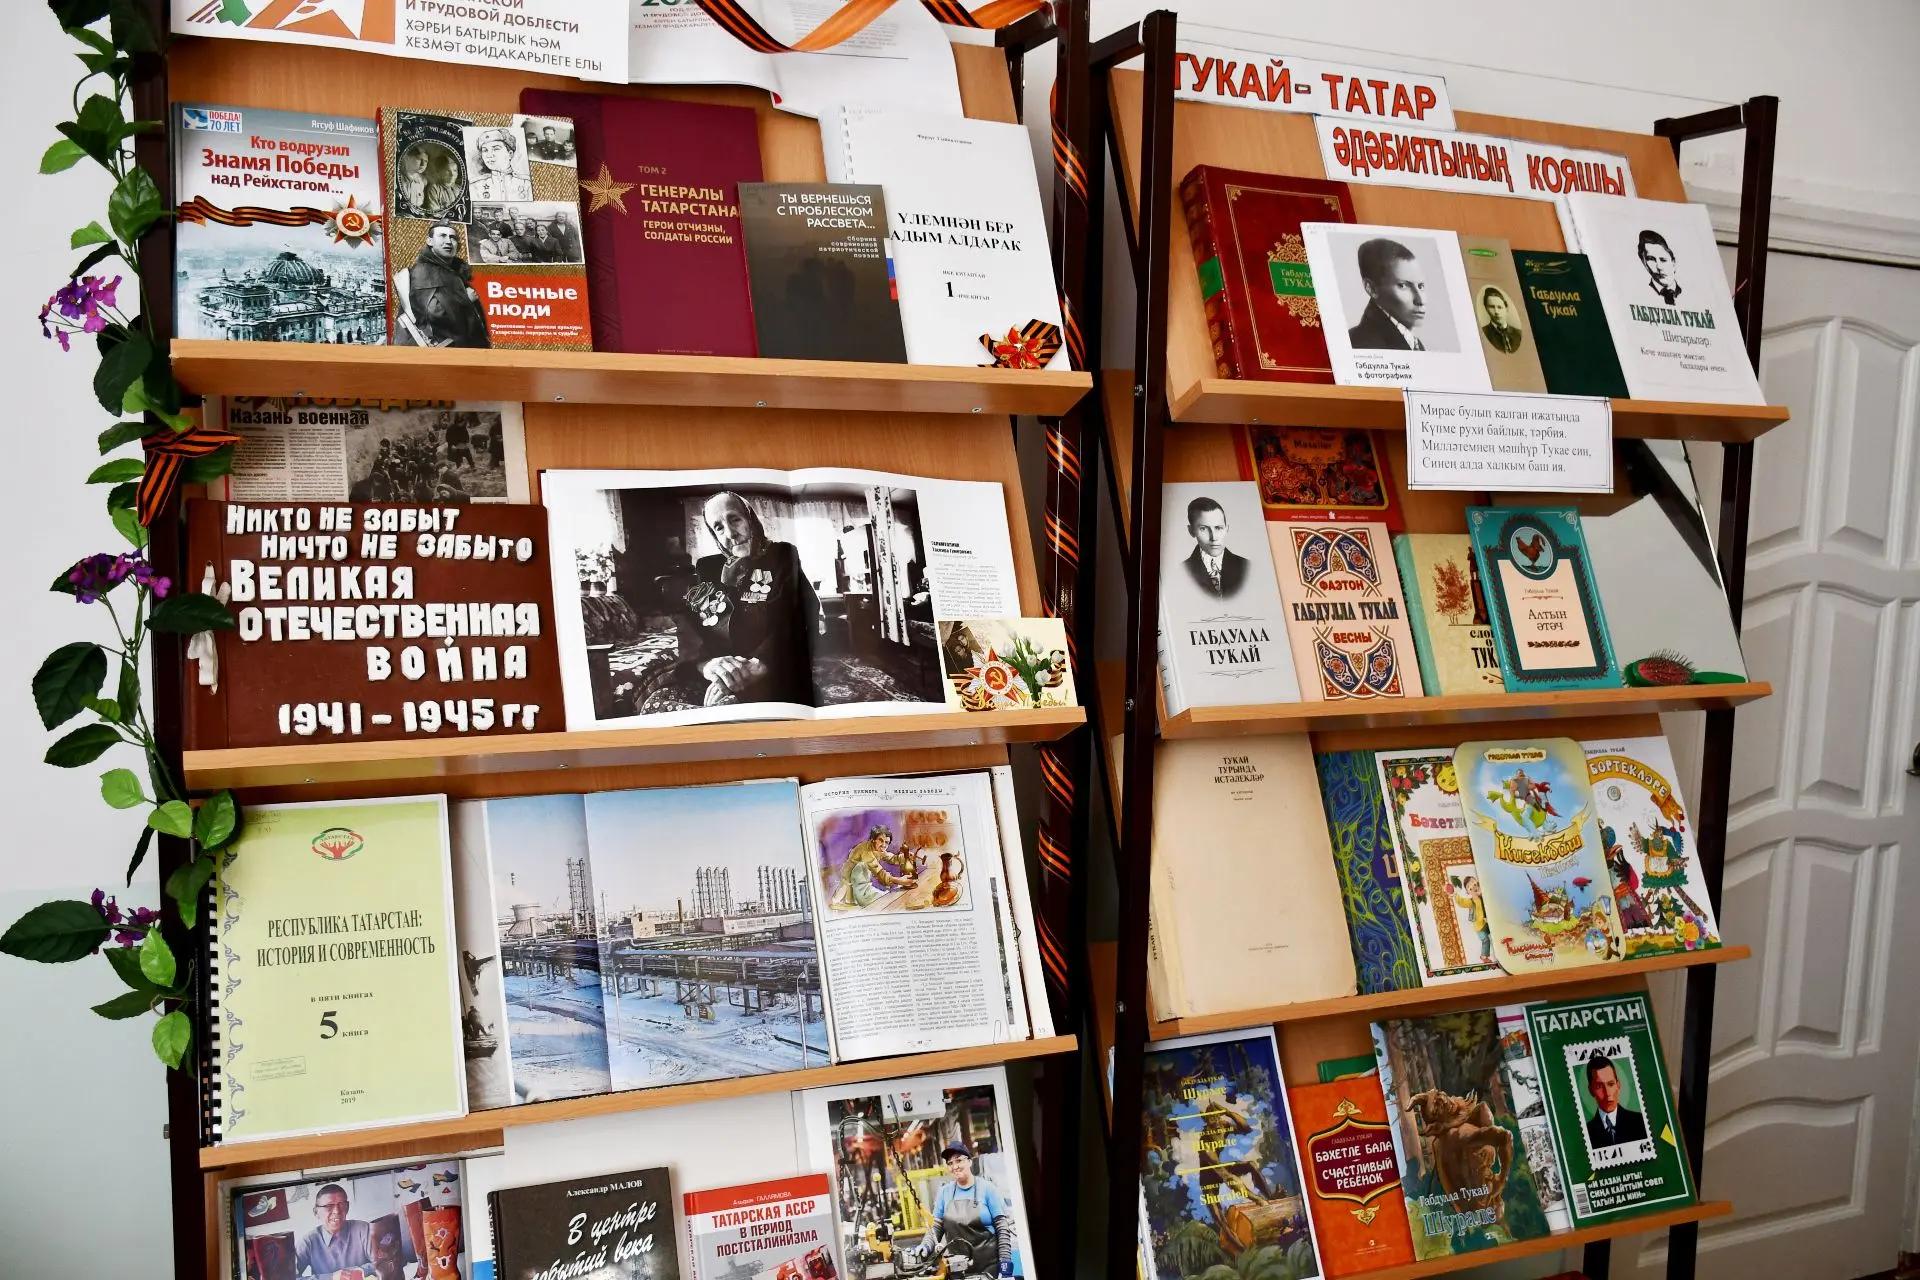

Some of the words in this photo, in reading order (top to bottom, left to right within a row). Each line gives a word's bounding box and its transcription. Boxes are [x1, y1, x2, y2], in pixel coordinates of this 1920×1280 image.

[405, 0, 417, 10] И
[420, 0, 499, 22] ТРУДОВОЙ
[504, 13, 579, 34] ДОБЛЕСТИ
[406, 19, 451, 35] ХӘРБИ
[455, 26, 526, 45] БАТЫРЛЫК
[405, 36, 461, 53] ХЕЗМӘТ
[465, 43, 572, 67] ФИДАКАРЬЛЕГЕ
[575, 59, 602, 72] ЕЛЫ
[1321, 73, 1437, 121] ТАТАР
[209, 110, 241, 121] ПОБЕДА!
[209, 120, 221, 131] 70
[223, 121, 241, 132] ЛЕТ
[251, 136, 276, 150] Кто
[279, 140, 350, 157] водрузил
[202, 149, 271, 171] Знамя
[276, 154, 360, 181] Победы
[638, 165, 659, 175] ТОМ
[661, 166, 668, 175] 2
[1332, 127, 1514, 193] ӘДӘБИЯТЫНЫҢ
[1526, 154, 1625, 196] КОЯШЫ
[211, 174, 240, 188] над
[640, 184, 724, 201] ГЕНЕРАЛЫ
[780, 193, 797, 204] ТЫ
[801, 194, 872, 205] ВЕРНЕШЬСЯ
[641, 200, 739, 217] ТАТАРСТАНА
[776, 206, 786, 216] С
[789, 206, 873, 217] ПРОБЛЕСКОМ
[643, 220, 675, 231] ГЕРОИ
[677, 221, 726, 234] ОТЧИЗНЫ,
[985, 220, 1014, 234] БЕР
[644, 231, 693, 243] СОЛДАТЫ
[695, 233, 733, 244] РОССИИ
[890, 230, 943, 244] АДЫМ
[947, 234, 1022, 252] АЛДАРАК
[487, 281, 577, 300] Вечные
[945, 281, 954, 298] 1
[1281, 277, 1314, 288] ТУКА
[1530, 286, 1582, 304] Габдулла
[488, 303, 551, 319] люди
[1542, 302, 1578, 319] Тукай
[1629, 303, 1682, 326] ГАБДУЛЛА
[1680, 309, 1716, 330] ТУКАЙ
[1355, 362, 1389, 370] Габдулла
[1389, 362, 1411, 370] Тукай
[1364, 371, 1413, 380] фотографиях
[229, 408, 293, 426] Казань
[298, 409, 370, 426] военная
[1420, 403, 1456, 418] Мирас
[1458, 405, 1492, 420] булып
[1494, 410, 1528, 420] калган
[1459, 425, 1484, 438] рухи
[1541, 443, 1570, 458] Тукае
[1459, 460, 1484, 470] алда
[1486, 461, 1525, 471] халкым
[1528, 459, 1549, 472] баш
[319, 507, 352, 532] НЕ
[361, 534, 397, 560] НЕ
[1319, 580, 1365, 591] ФАЭТОН
[1292, 601, 1354, 624] ГАБДУЛЛА
[1358, 598, 1399, 621] ТУКАЙ
[1528, 608, 1568, 620] Алтын
[239, 602, 541, 642] ОТЕЧЕСТВЕННАЯ
[1536, 622, 1565, 631] әтәч
[1189, 626, 1270, 647] ГАБДУЛЛА
[1332, 631, 1373, 644] ВЕСНЫ
[367, 635, 527, 683] ВОЙНА
[1206, 644, 1261, 665] ТУКАЙ
[1471, 647, 1499, 669] ТУК
[279, 702, 362, 735] 1941
[403, 699, 495, 733] 1945
[1223, 755, 1249, 765] ТУКАЙ
[1214, 773, 1265, 784] ИСТӘЛЕКЛӘР
[1217, 765, 1257, 775] ТУРЫНДА
[1409, 813, 1464, 829] Бәхетл
[1496, 833, 1583, 865] Кисекбаш
[268, 915, 349, 938] РЕСПУБЛИКА
[352, 908, 423, 932] ТАТАРСТАН:
[257, 944, 316, 967] ИСТОРИЯ
[319, 943, 327, 961] И
[329, 935, 436, 960] СОВРЕМЕННОСТЬ
[342, 991, 374, 1000] книгах
[320, 1010, 338, 1039] 5
[342, 1029, 369, 1038] книга
[1536, 1002, 1643, 1033] ТАТАРСТАН
[1315, 1145, 1362, 1163] БӘХЕТЛЕ
[1365, 1140, 1393, 1155] БАЛА
[1322, 1156, 1394, 1180] СЧАСТЛИВЫЙ
[566, 1186, 609, 1198] Александр
[609, 1179, 643, 1192] МАЛОВ
[1600, 1175, 1622, 1187] КАЗАН
[1610, 1181, 1644, 1194] КАЙТТЫМ
[1418, 1192, 1460, 1207] Габдулла
[1460, 1183, 1490, 1202] Тукай
[1591, 1197, 1615, 1208] ТАГЫН
[1616, 1194, 1627, 1204] ДА
[712, 1206, 781, 1228] ТАТАРСКАЯ
[785, 1199, 816, 1218] АССР
[568, 1212, 587, 1245] В
[590, 1200, 657, 1246] центре
[739, 1226, 748, 1239] В
[751, 1219, 794, 1237] ПЕРИОД
[716, 1229, 819, 1257] ПОСТСТАЛИНИЗМА
[531, 1245, 608, 1280] событий
[614, 1231, 654, 1263] века
